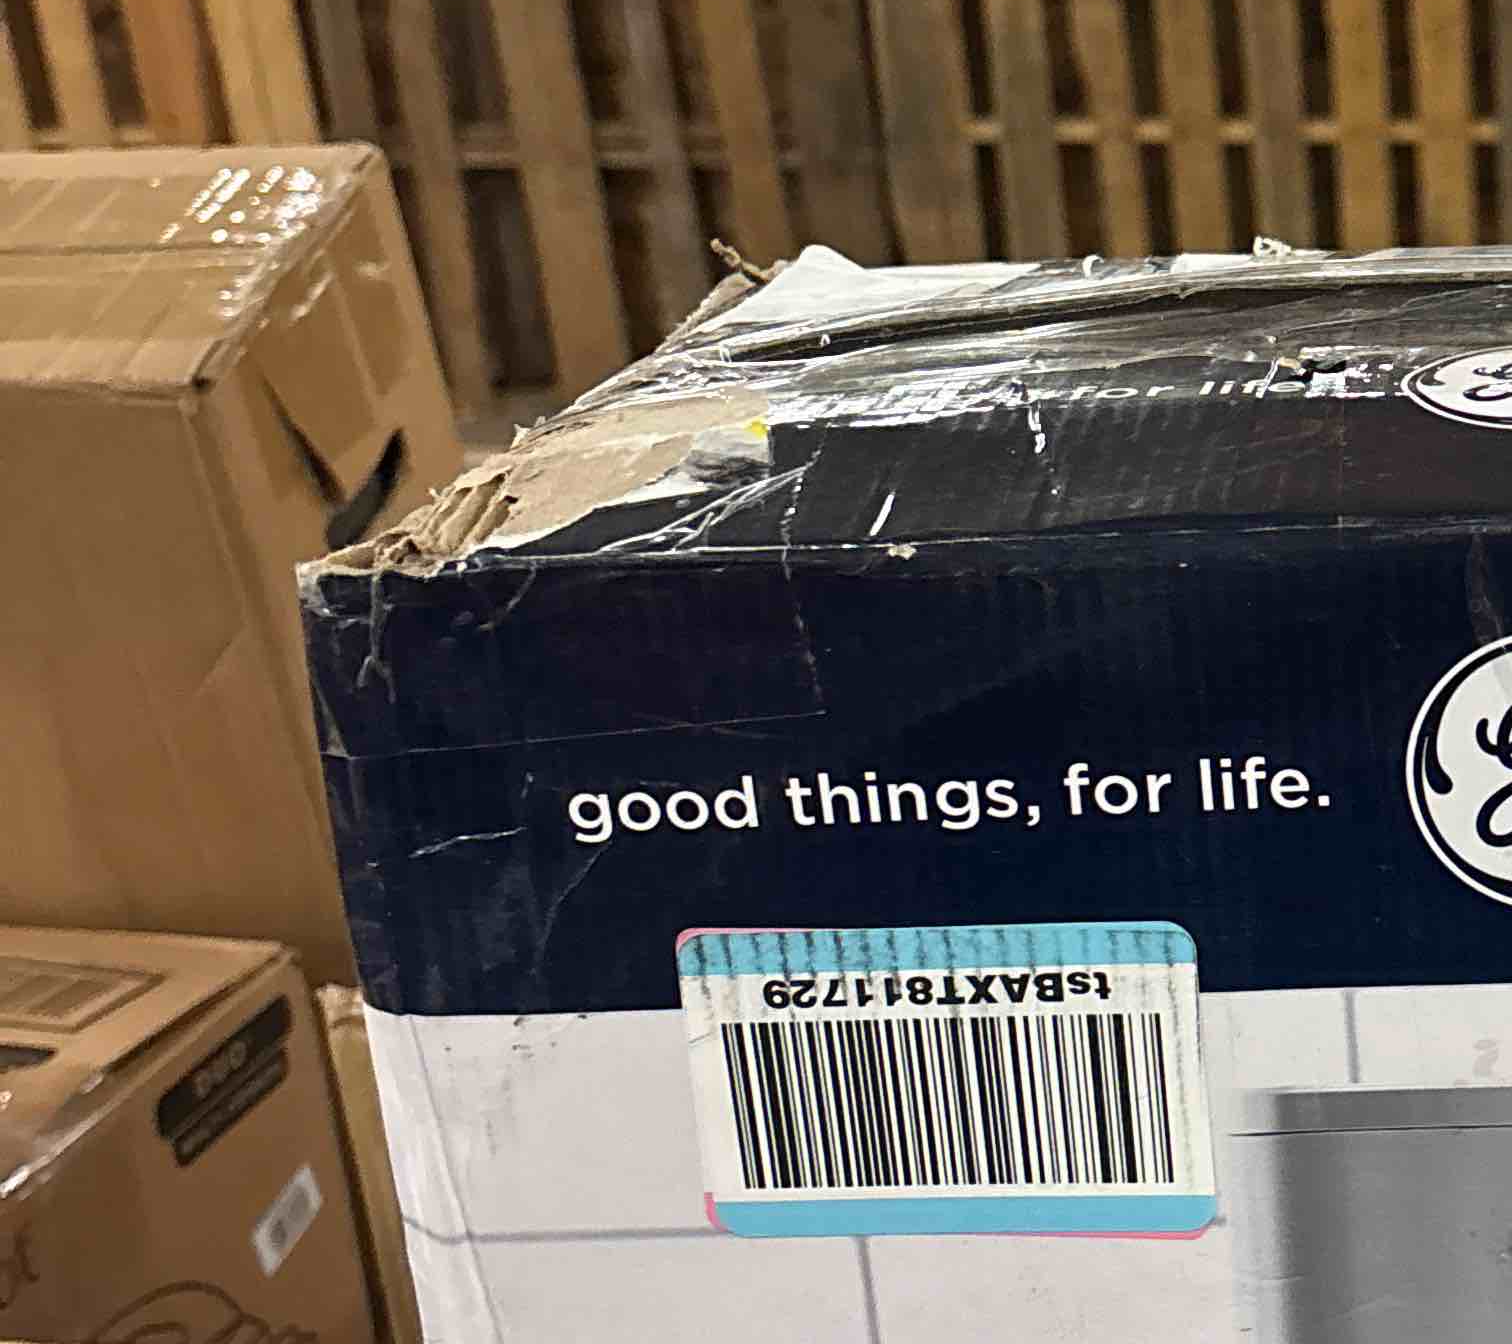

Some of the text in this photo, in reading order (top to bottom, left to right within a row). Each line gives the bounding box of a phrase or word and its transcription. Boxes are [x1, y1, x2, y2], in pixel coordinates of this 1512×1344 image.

[568, 755, 1331, 843] good things, for life.
[762, 970, 1113, 1010] tsBAXT811729
